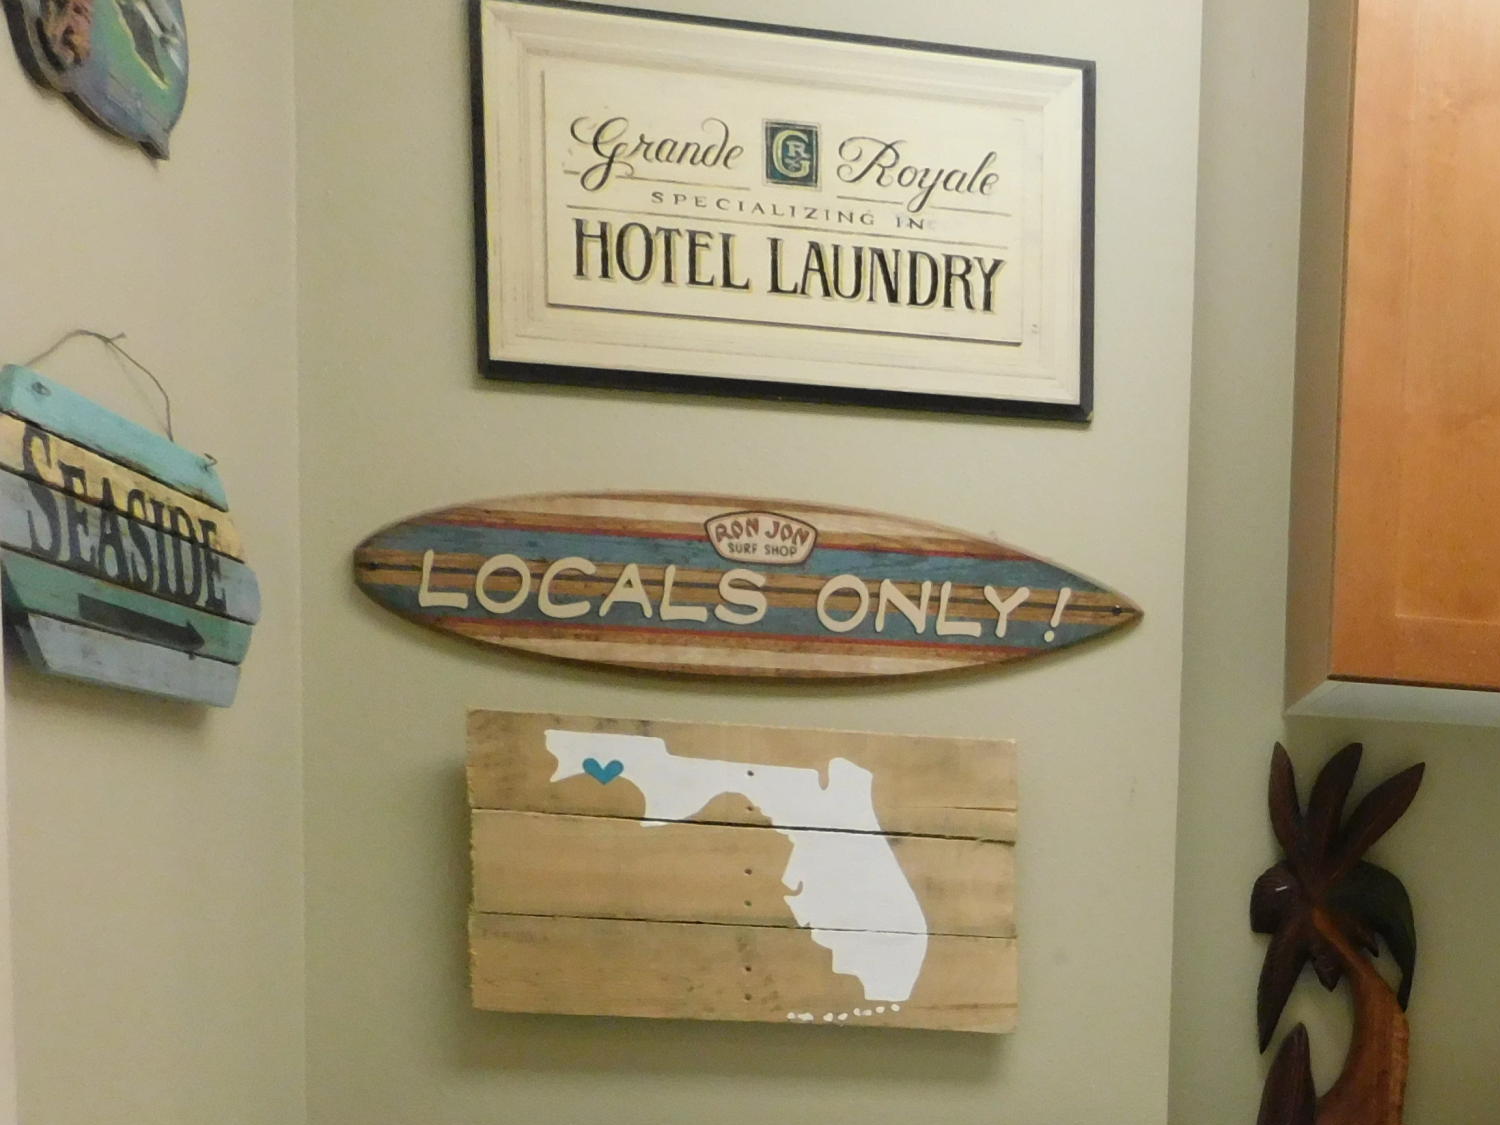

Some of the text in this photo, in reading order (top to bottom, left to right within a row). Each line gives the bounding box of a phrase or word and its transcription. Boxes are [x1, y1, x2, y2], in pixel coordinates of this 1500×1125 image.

[569, 117, 1001, 213] Grande Royale
[651, 190, 926, 230] SPECIALIZING IN
[573, 217, 1005, 314] HOTEL LAUNDRY
[22, 420, 228, 613] SEASIDE
[715, 517, 810, 547] RON JON
[728, 542, 798, 557] SURF SHOP
[417, 549, 1073, 643] LOCALS ONLY!
